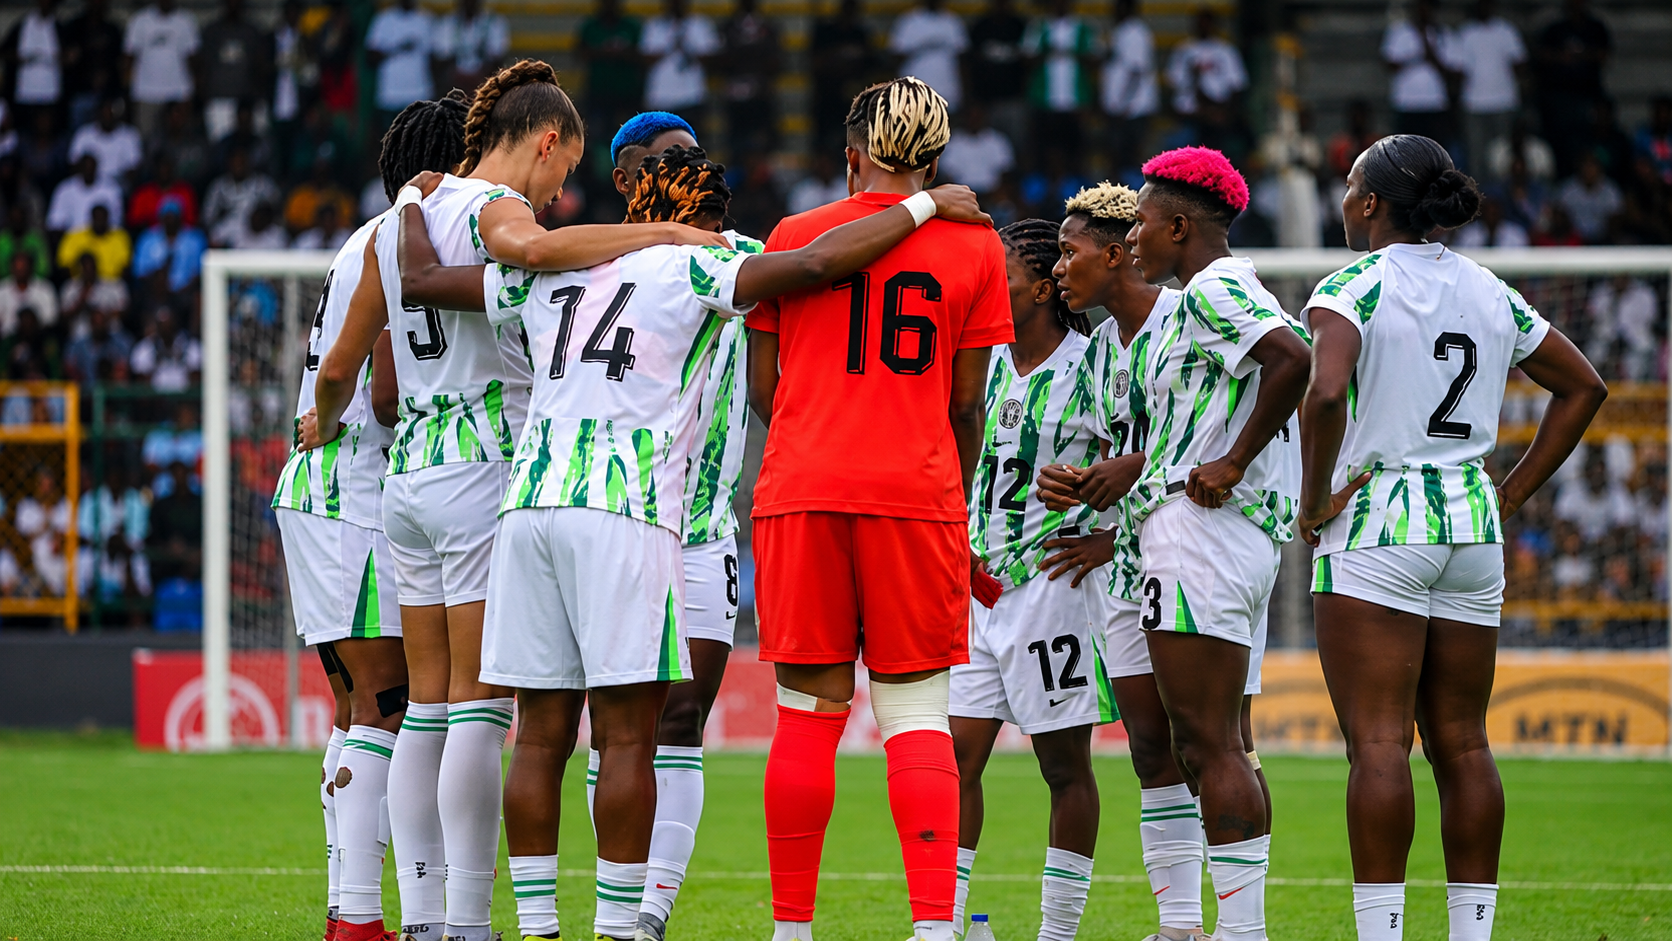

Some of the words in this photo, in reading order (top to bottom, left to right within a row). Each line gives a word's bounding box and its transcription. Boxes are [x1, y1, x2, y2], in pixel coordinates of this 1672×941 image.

[549, 282, 637, 382] 14
[832, 271, 942, 376] 16
[1427, 331, 1477, 440] 2
[984, 455, 1032, 514] 12
[723, 553, 738, 607] 8
[1142, 577, 1161, 630] 3
[1028, 634, 1088, 692] 12
[1513, 713, 1628, 749] MTN
